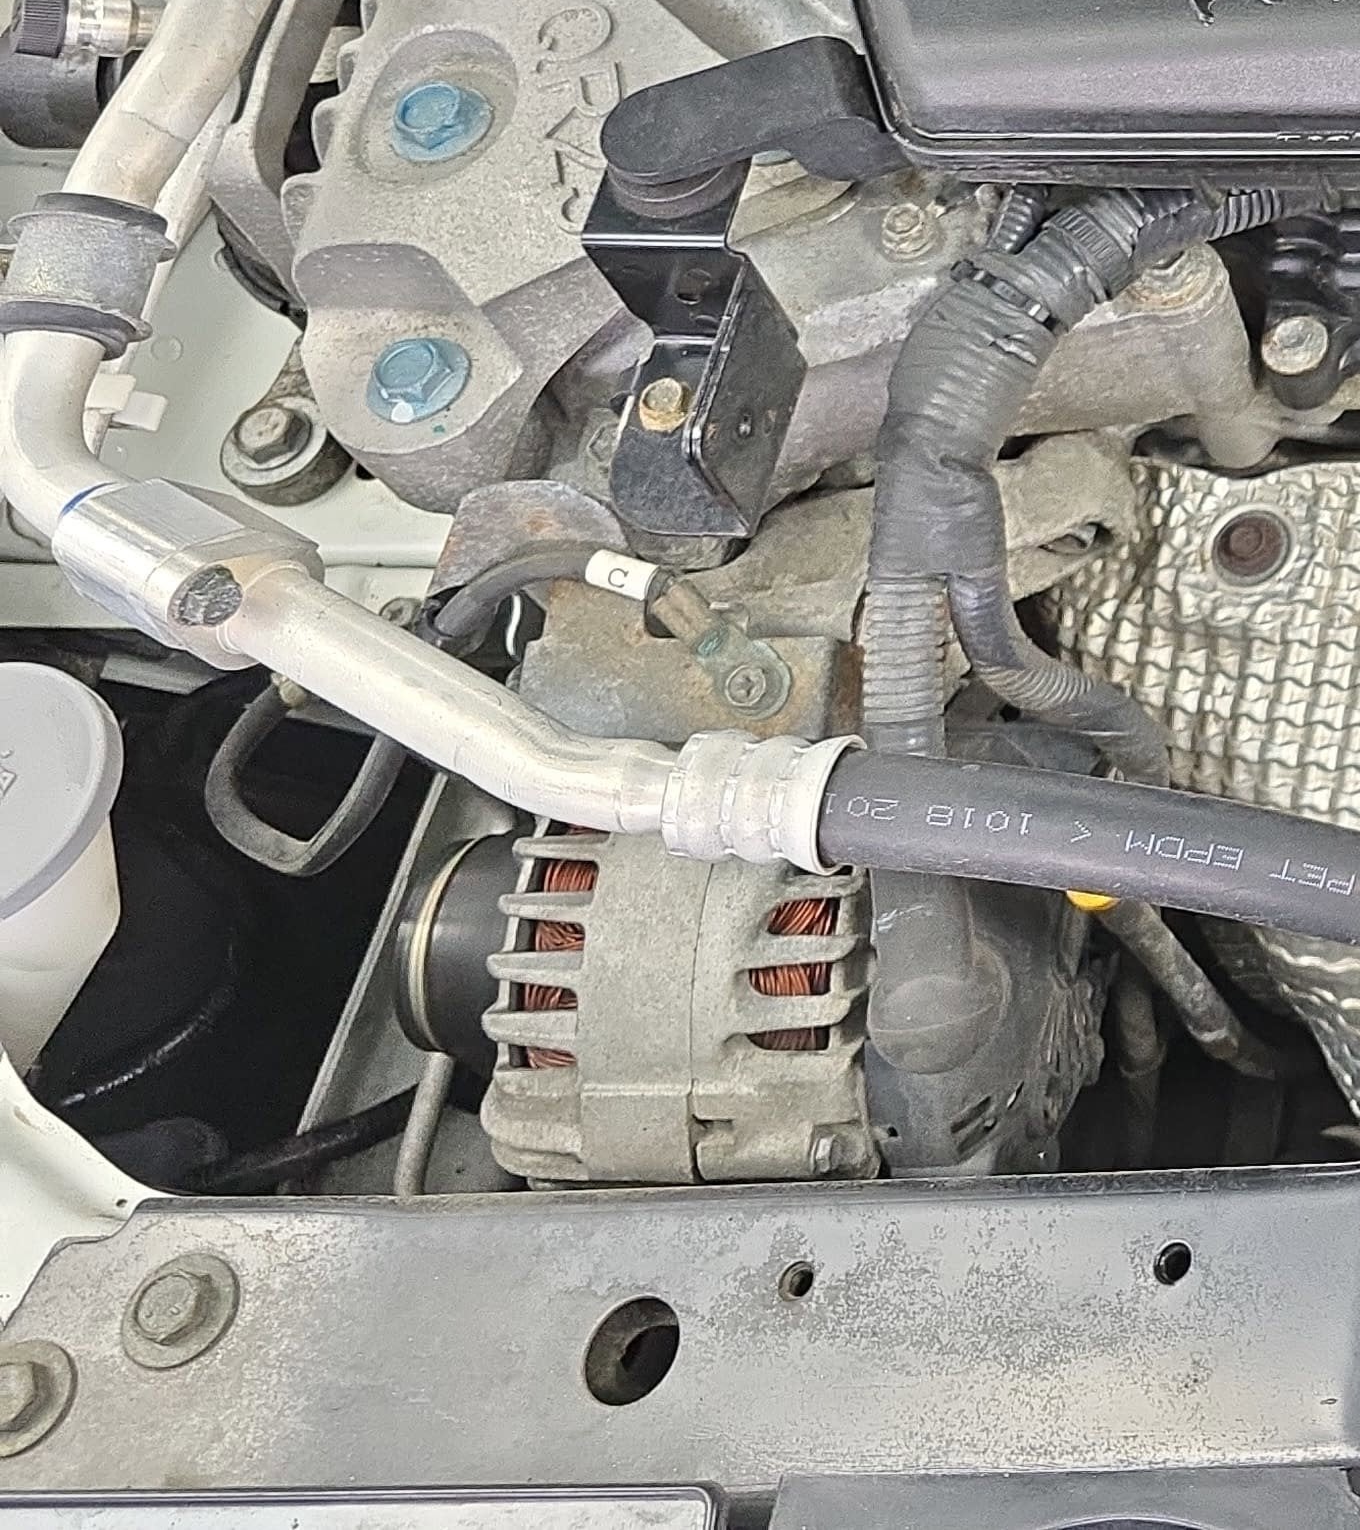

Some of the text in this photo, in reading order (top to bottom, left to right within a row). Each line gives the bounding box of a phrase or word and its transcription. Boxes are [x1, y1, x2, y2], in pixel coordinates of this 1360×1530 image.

[925, 803, 1033, 836] 1018
[1124, 830, 1244, 871] EPDM
[1268, 858, 1356, 897] PET
